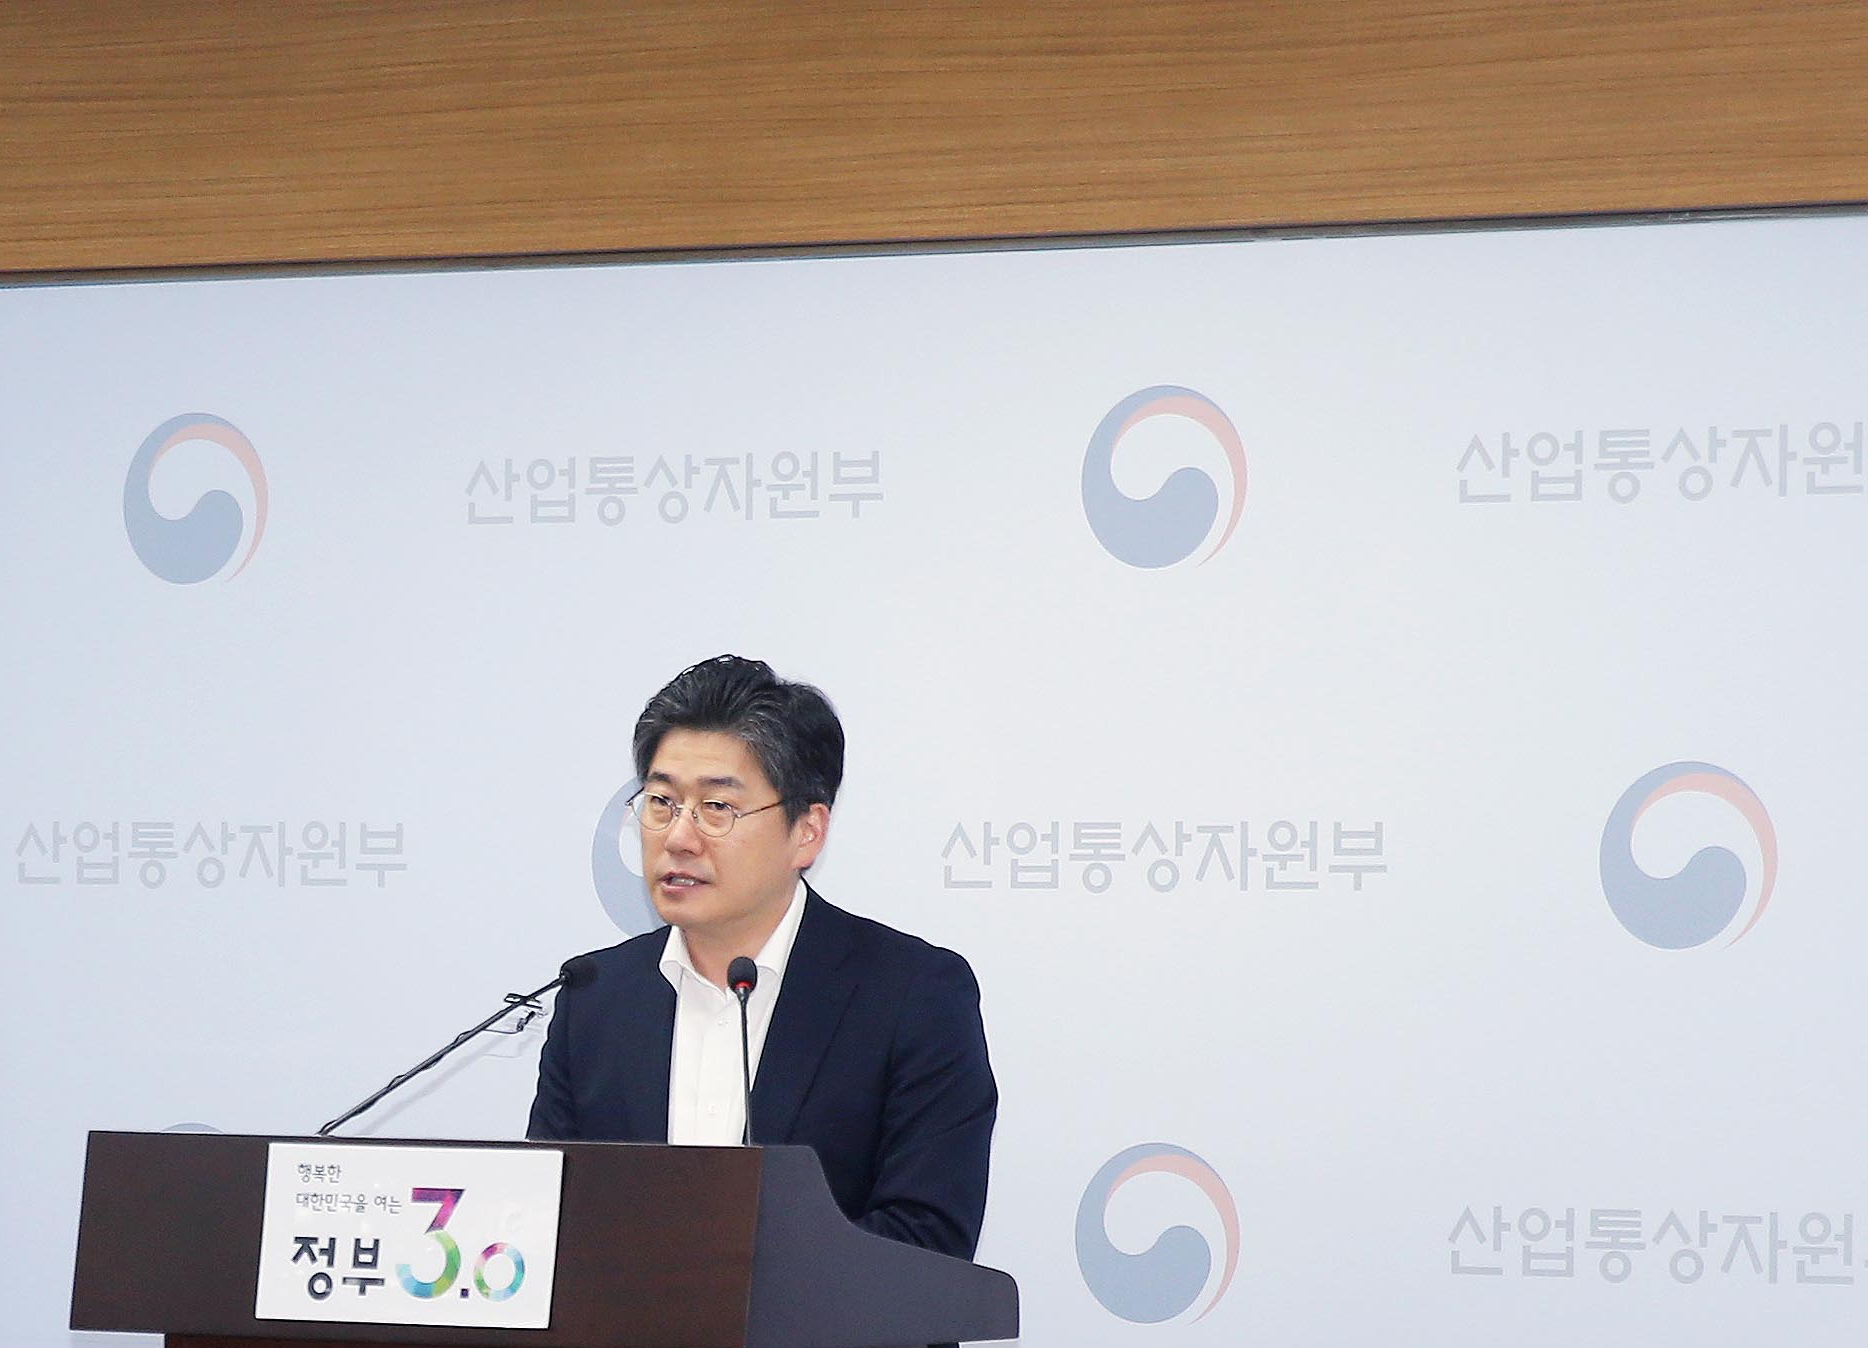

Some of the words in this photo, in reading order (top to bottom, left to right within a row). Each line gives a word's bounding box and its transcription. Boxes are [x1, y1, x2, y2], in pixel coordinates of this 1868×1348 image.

[465, 450, 884, 527] 산업통상자원부
[15, 820, 408, 889] 산업통상자원부
[941, 819, 1388, 893] 산업통상자원부
[295, 1192, 368, 1213] 대한민국을
[373, 1195, 402, 1214] 여는
[297, 1163, 341, 1183] 행복한
[292, 1237, 385, 1300] 정부
[395, 1187, 525, 1301] 3.0
[1448, 1205, 1868, 1284] 산업통상자원
